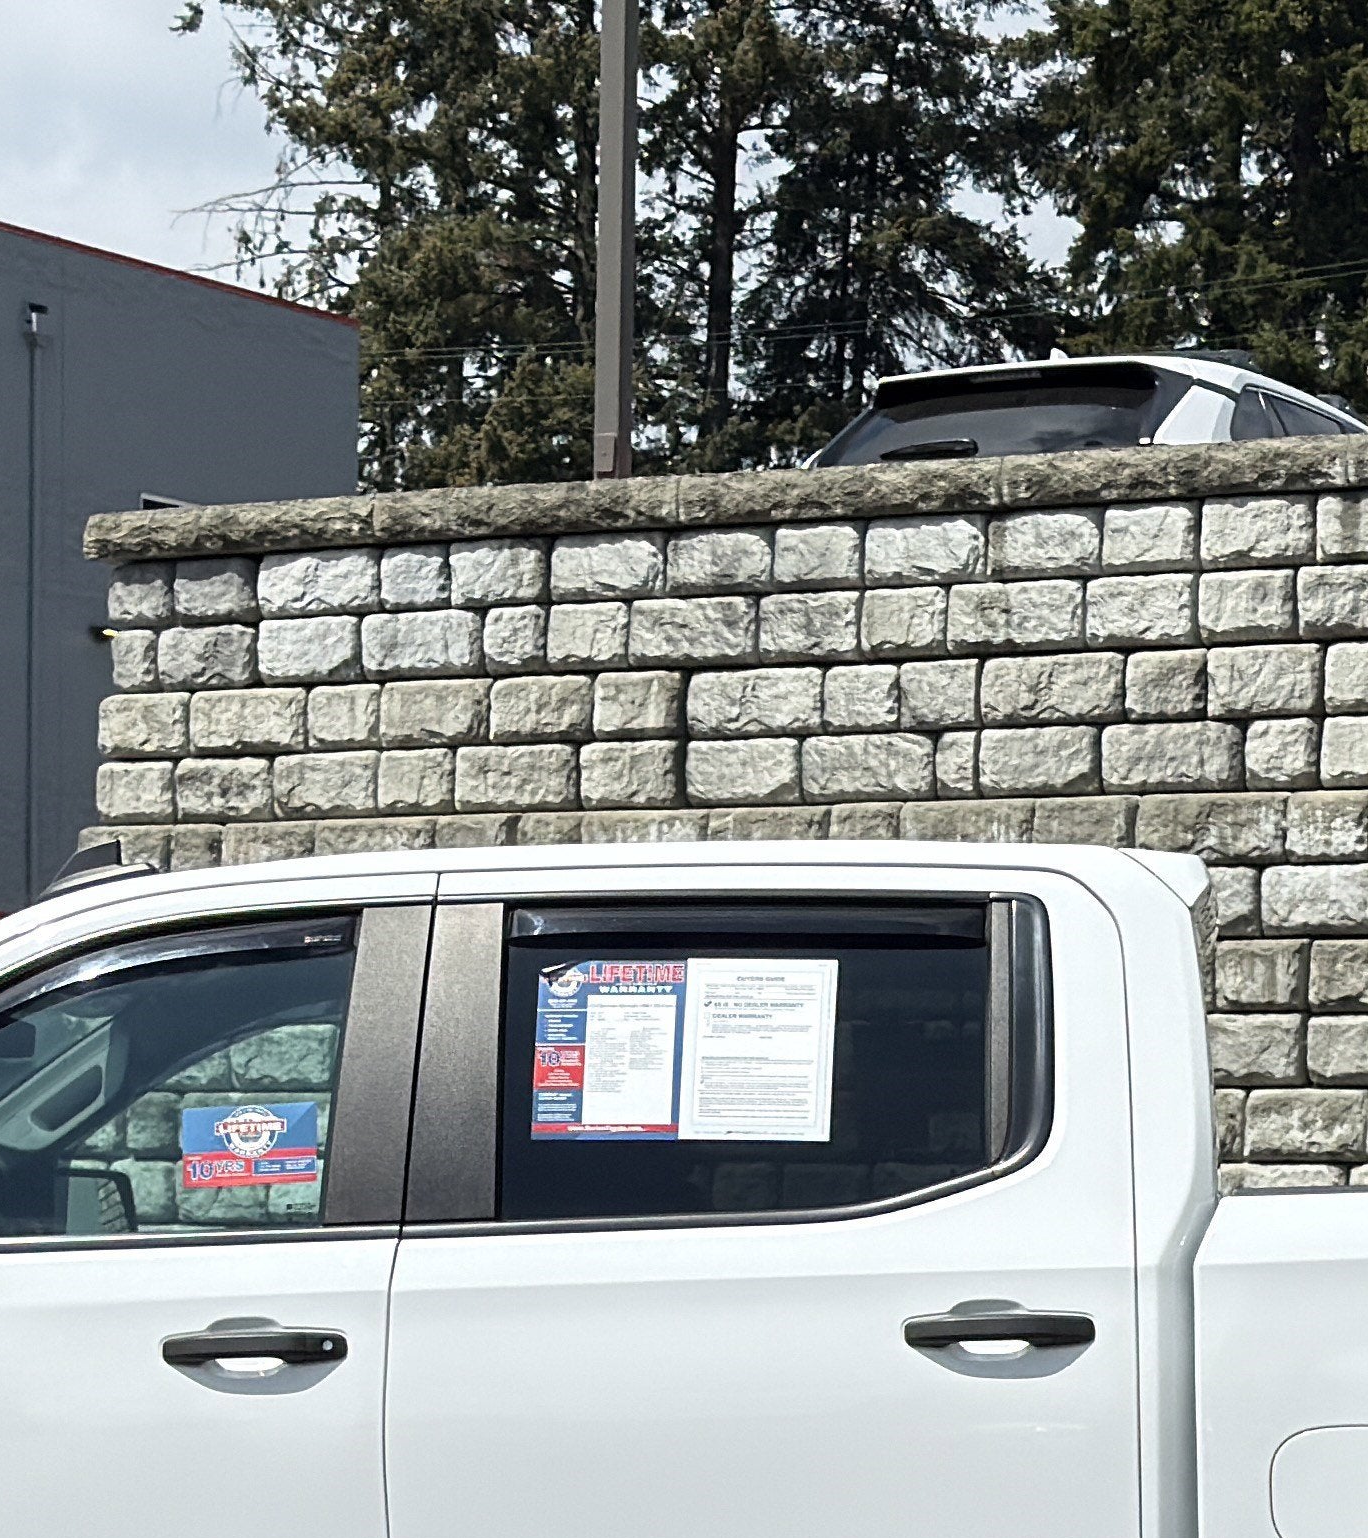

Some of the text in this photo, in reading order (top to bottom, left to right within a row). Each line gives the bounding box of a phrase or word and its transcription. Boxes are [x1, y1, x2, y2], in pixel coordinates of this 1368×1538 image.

[589, 964, 684, 983] LIFETIME
[599, 985, 673, 994] WARRANTY
[187, 1160, 213, 1181] 10
[216, 1160, 245, 1174] YRS
